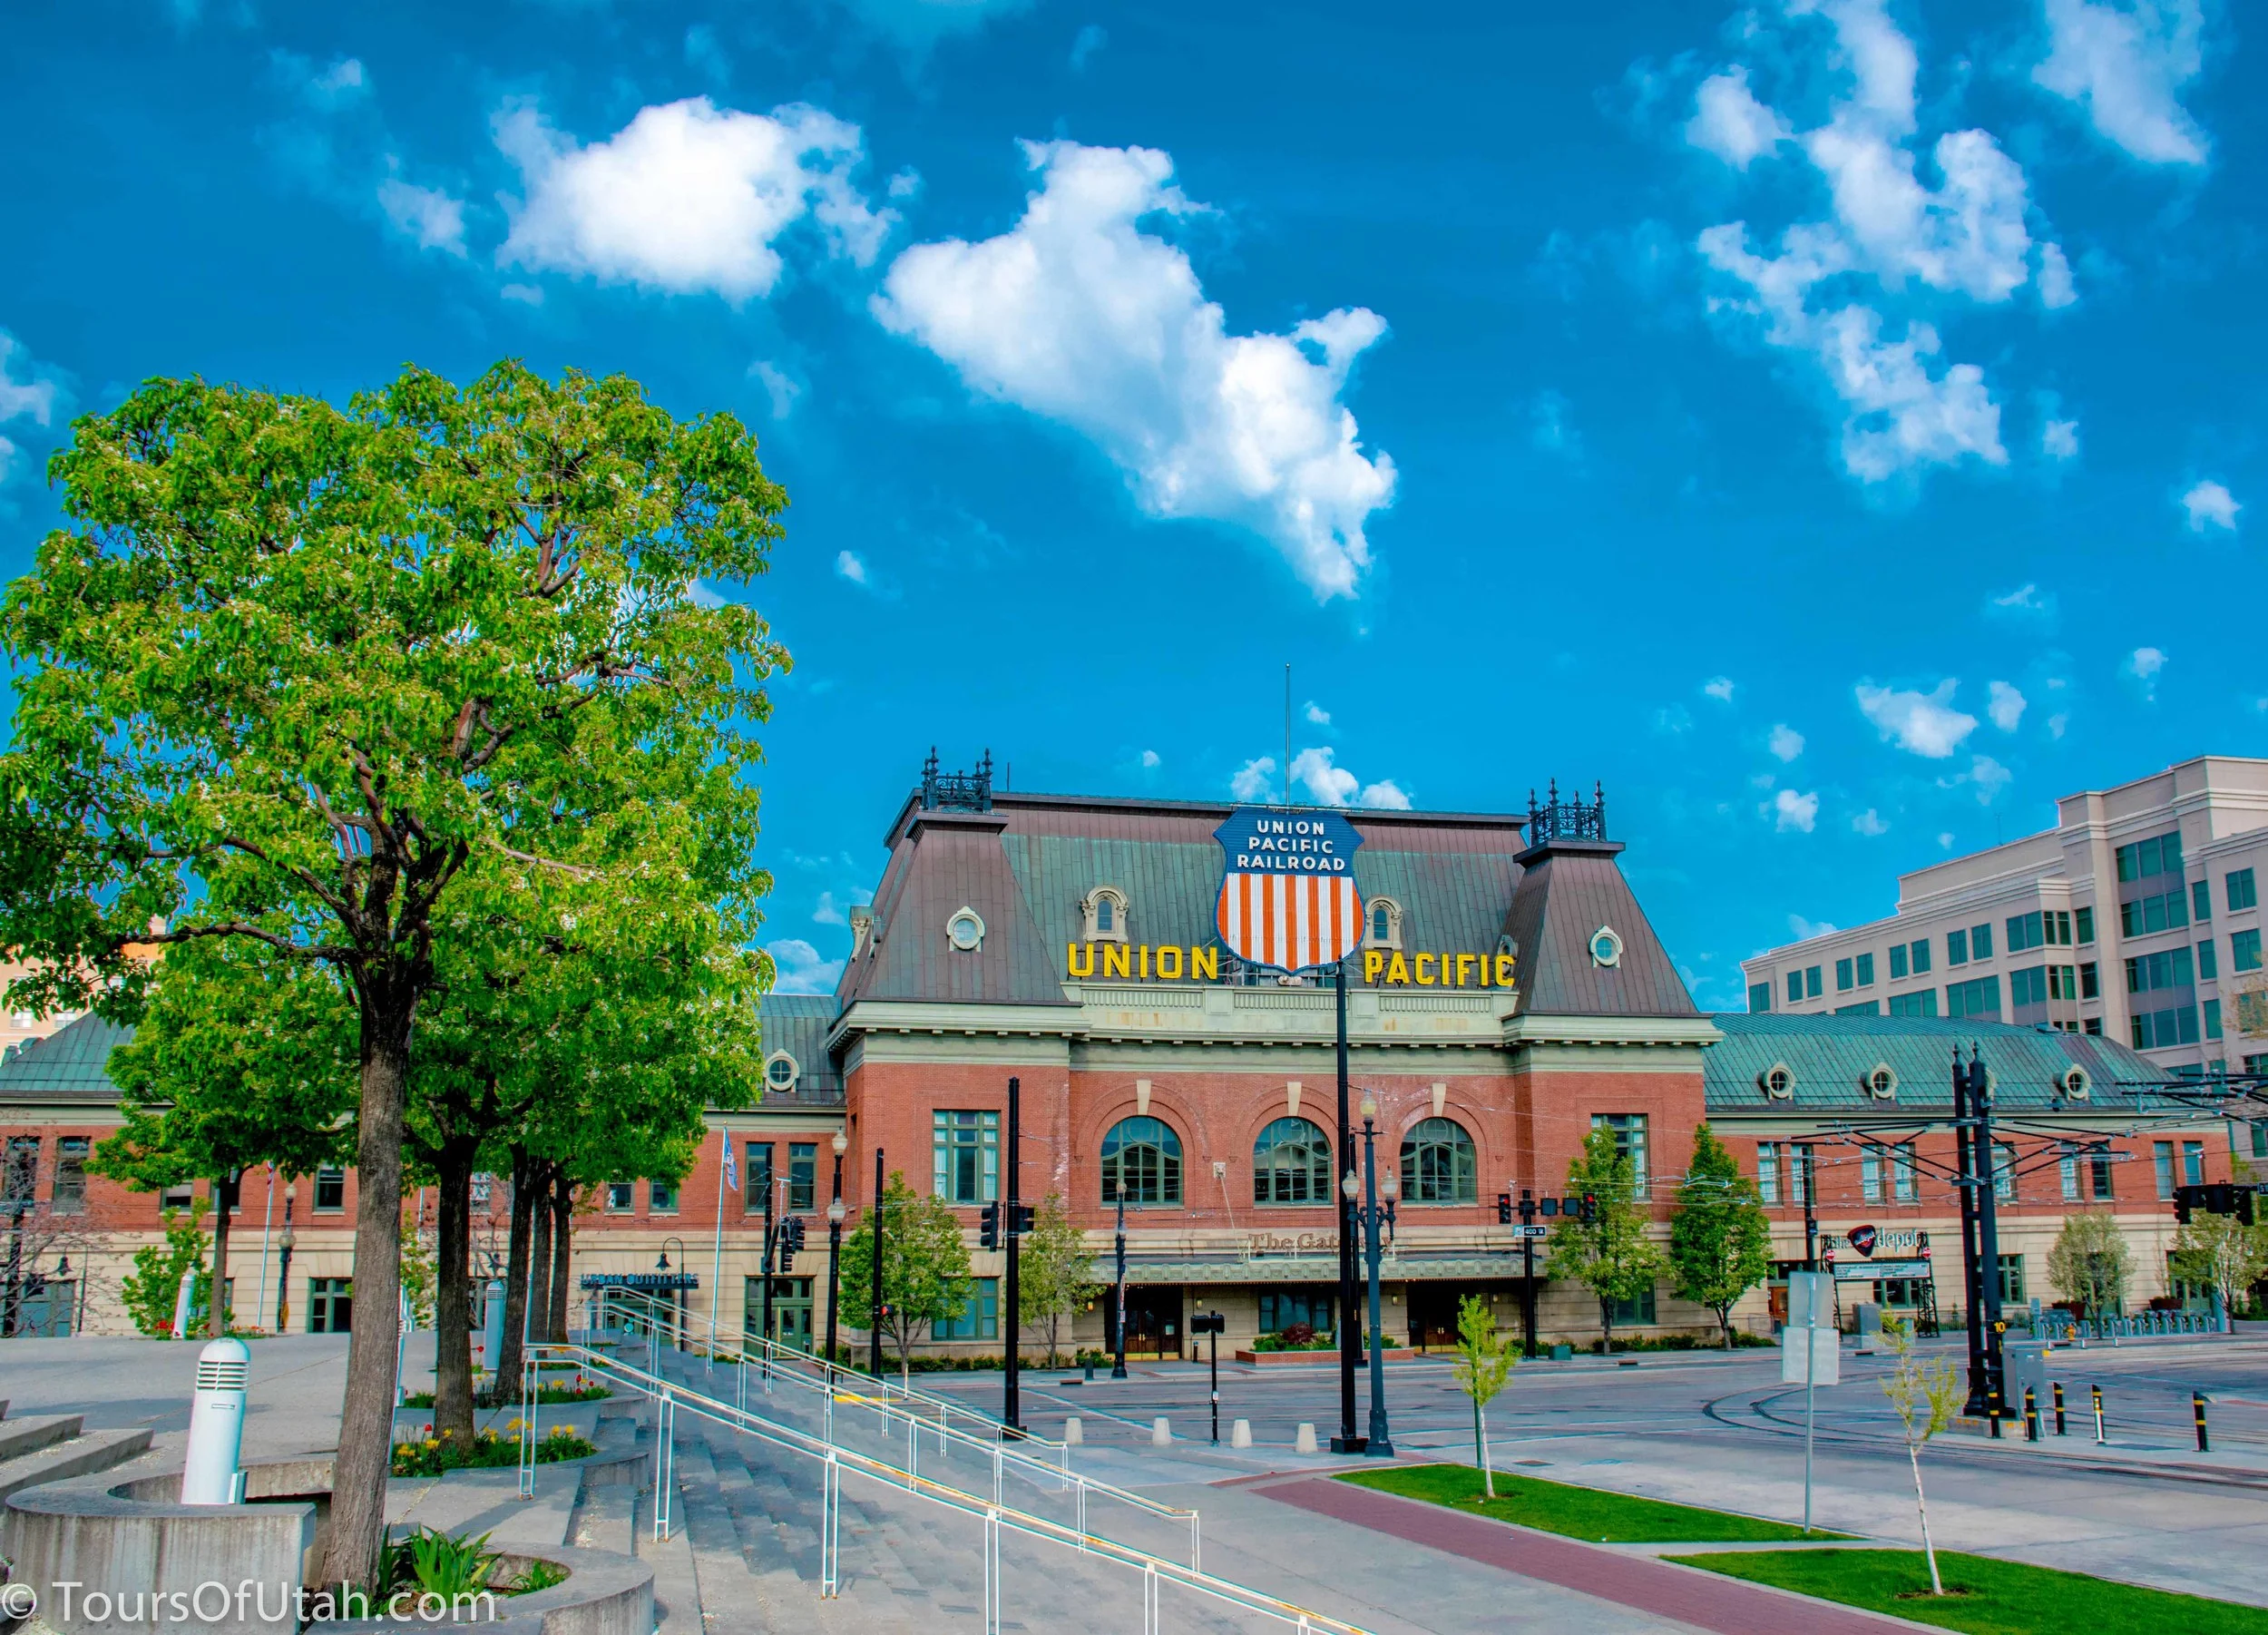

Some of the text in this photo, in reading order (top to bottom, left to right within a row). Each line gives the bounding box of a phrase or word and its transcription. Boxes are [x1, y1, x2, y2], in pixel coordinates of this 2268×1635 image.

[1256, 819, 1325, 835] UNION
[1248, 837, 1334, 854] PACIFIC
[1237, 855, 1345, 872] RAILROAD
[1067, 943, 1516, 987] UNION PACIFIC
[1248, 1233, 1295, 1250] The
[1876, 1227, 1919, 1253] depot
[581, 1273, 699, 1285] URBAN OUTFITTERS
[1994, 1321, 2006, 1333] 10
